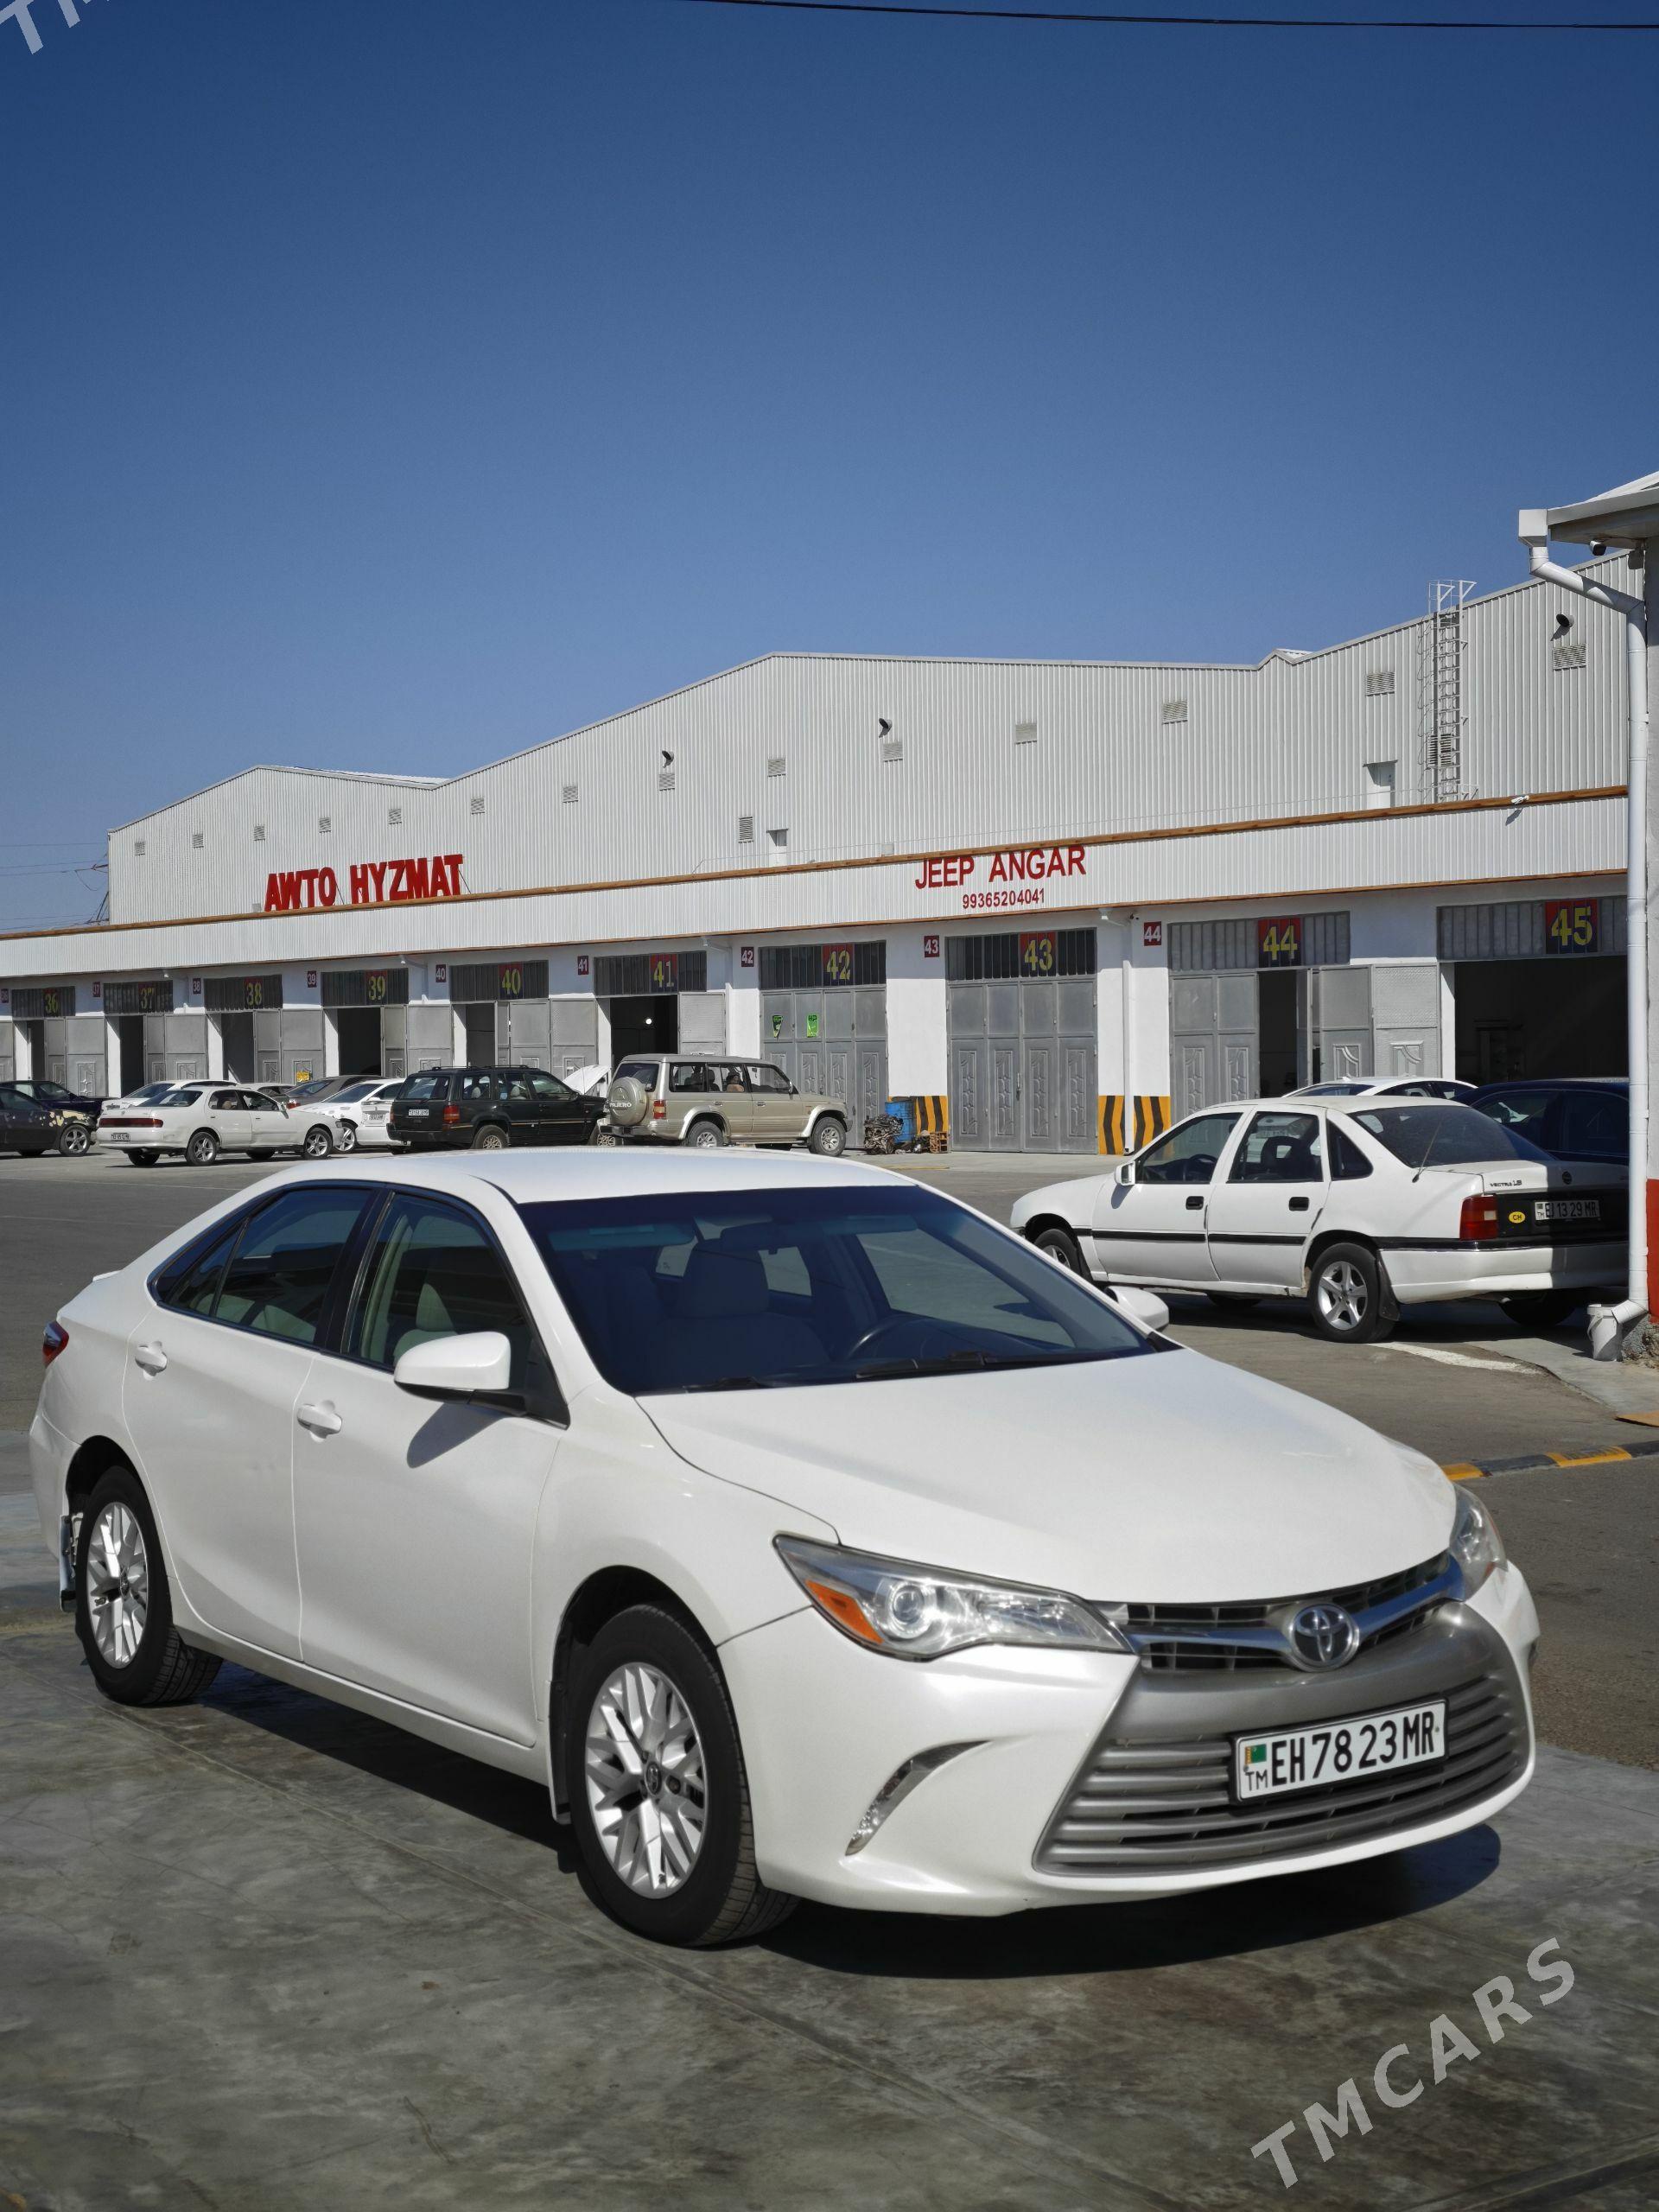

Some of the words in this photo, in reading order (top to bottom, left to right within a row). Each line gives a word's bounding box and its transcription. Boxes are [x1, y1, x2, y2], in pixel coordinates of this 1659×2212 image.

[915, 855, 975, 889] JEEP
[988, 845, 1086, 883] ANGAR
[264, 867, 337, 912] AWTO
[350, 854, 463, 905] HYZMAT
[963, 888, 1045, 909] 99365204041
[1144, 925, 1161, 943] 44
[1551, 907, 1592, 947] 45
[925, 938, 939, 954] 43
[1262, 925, 1297, 960] 44
[578, 958, 588, 972] 41
[741, 950, 753, 964] 42
[827, 950, 851, 980] 42
[1025, 938, 1053, 971] 43
[308, 973, 316, 985] 39
[435, 967, 446, 980] 40
[502, 969, 522, 995] 40
[653, 960, 674, 988] 41
[193, 981, 200, 993] 38
[245, 982, 263, 1006] 38
[368, 975, 386, 1001] 39
[45, 993, 59, 1014] 36
[1245, 1770, 1268, 1791] TM
